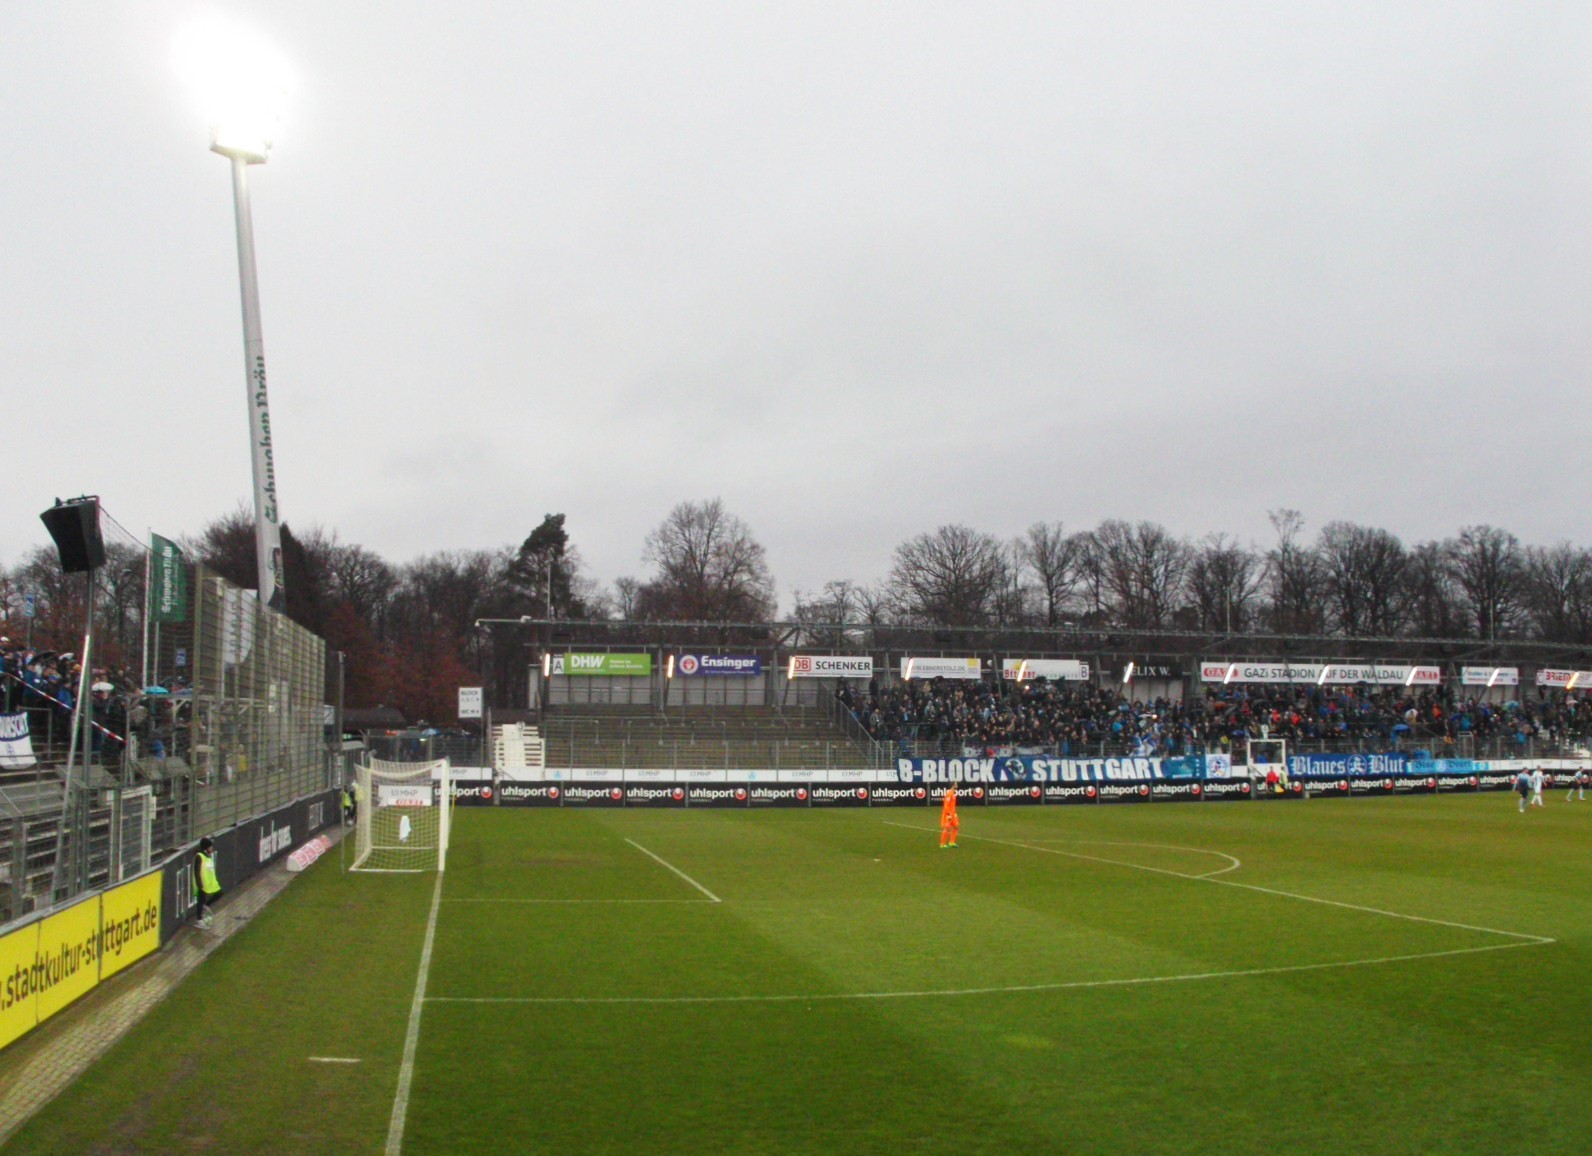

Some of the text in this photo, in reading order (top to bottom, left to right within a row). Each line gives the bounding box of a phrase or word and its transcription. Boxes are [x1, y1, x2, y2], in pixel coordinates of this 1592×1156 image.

[571, 655, 605, 668] DHW
[701, 656, 756, 669] Ensinger
[815, 658, 871, 671] SCHENKER
[1272, 668, 1315, 679] STADION
[1341, 669, 1359, 680] DER
[1361, 669, 1404, 680] WALDAU
[899, 757, 1163, 783] B-BLOCK STUTTGART
[1290, 754, 1404, 776] Blaues Blut
[1304, 780, 1339, 790] uhlsport
[1350, 778, 1384, 789] uhlsport
[1395, 777, 1428, 788] uhlsport
[1438, 777, 1469, 786] uhlsport
[501, 786, 547, 798] uhlsport
[564, 787, 610, 798] uhlsport
[626, 787, 672, 798] uhlsport
[689, 787, 735, 799] uhlsport
[751, 787, 796, 799] uhlsport
[812, 787, 856, 798] uhlsport
[872, 787, 915, 798] uhlsport
[988, 785, 1030, 797] uhlsport
[1045, 785, 1085, 796] uhlsport
[1100, 784, 1138, 796] uhlsport
[1153, 783, 1191, 794] uhlsport
[1204, 782, 1241, 793] uhlsport
